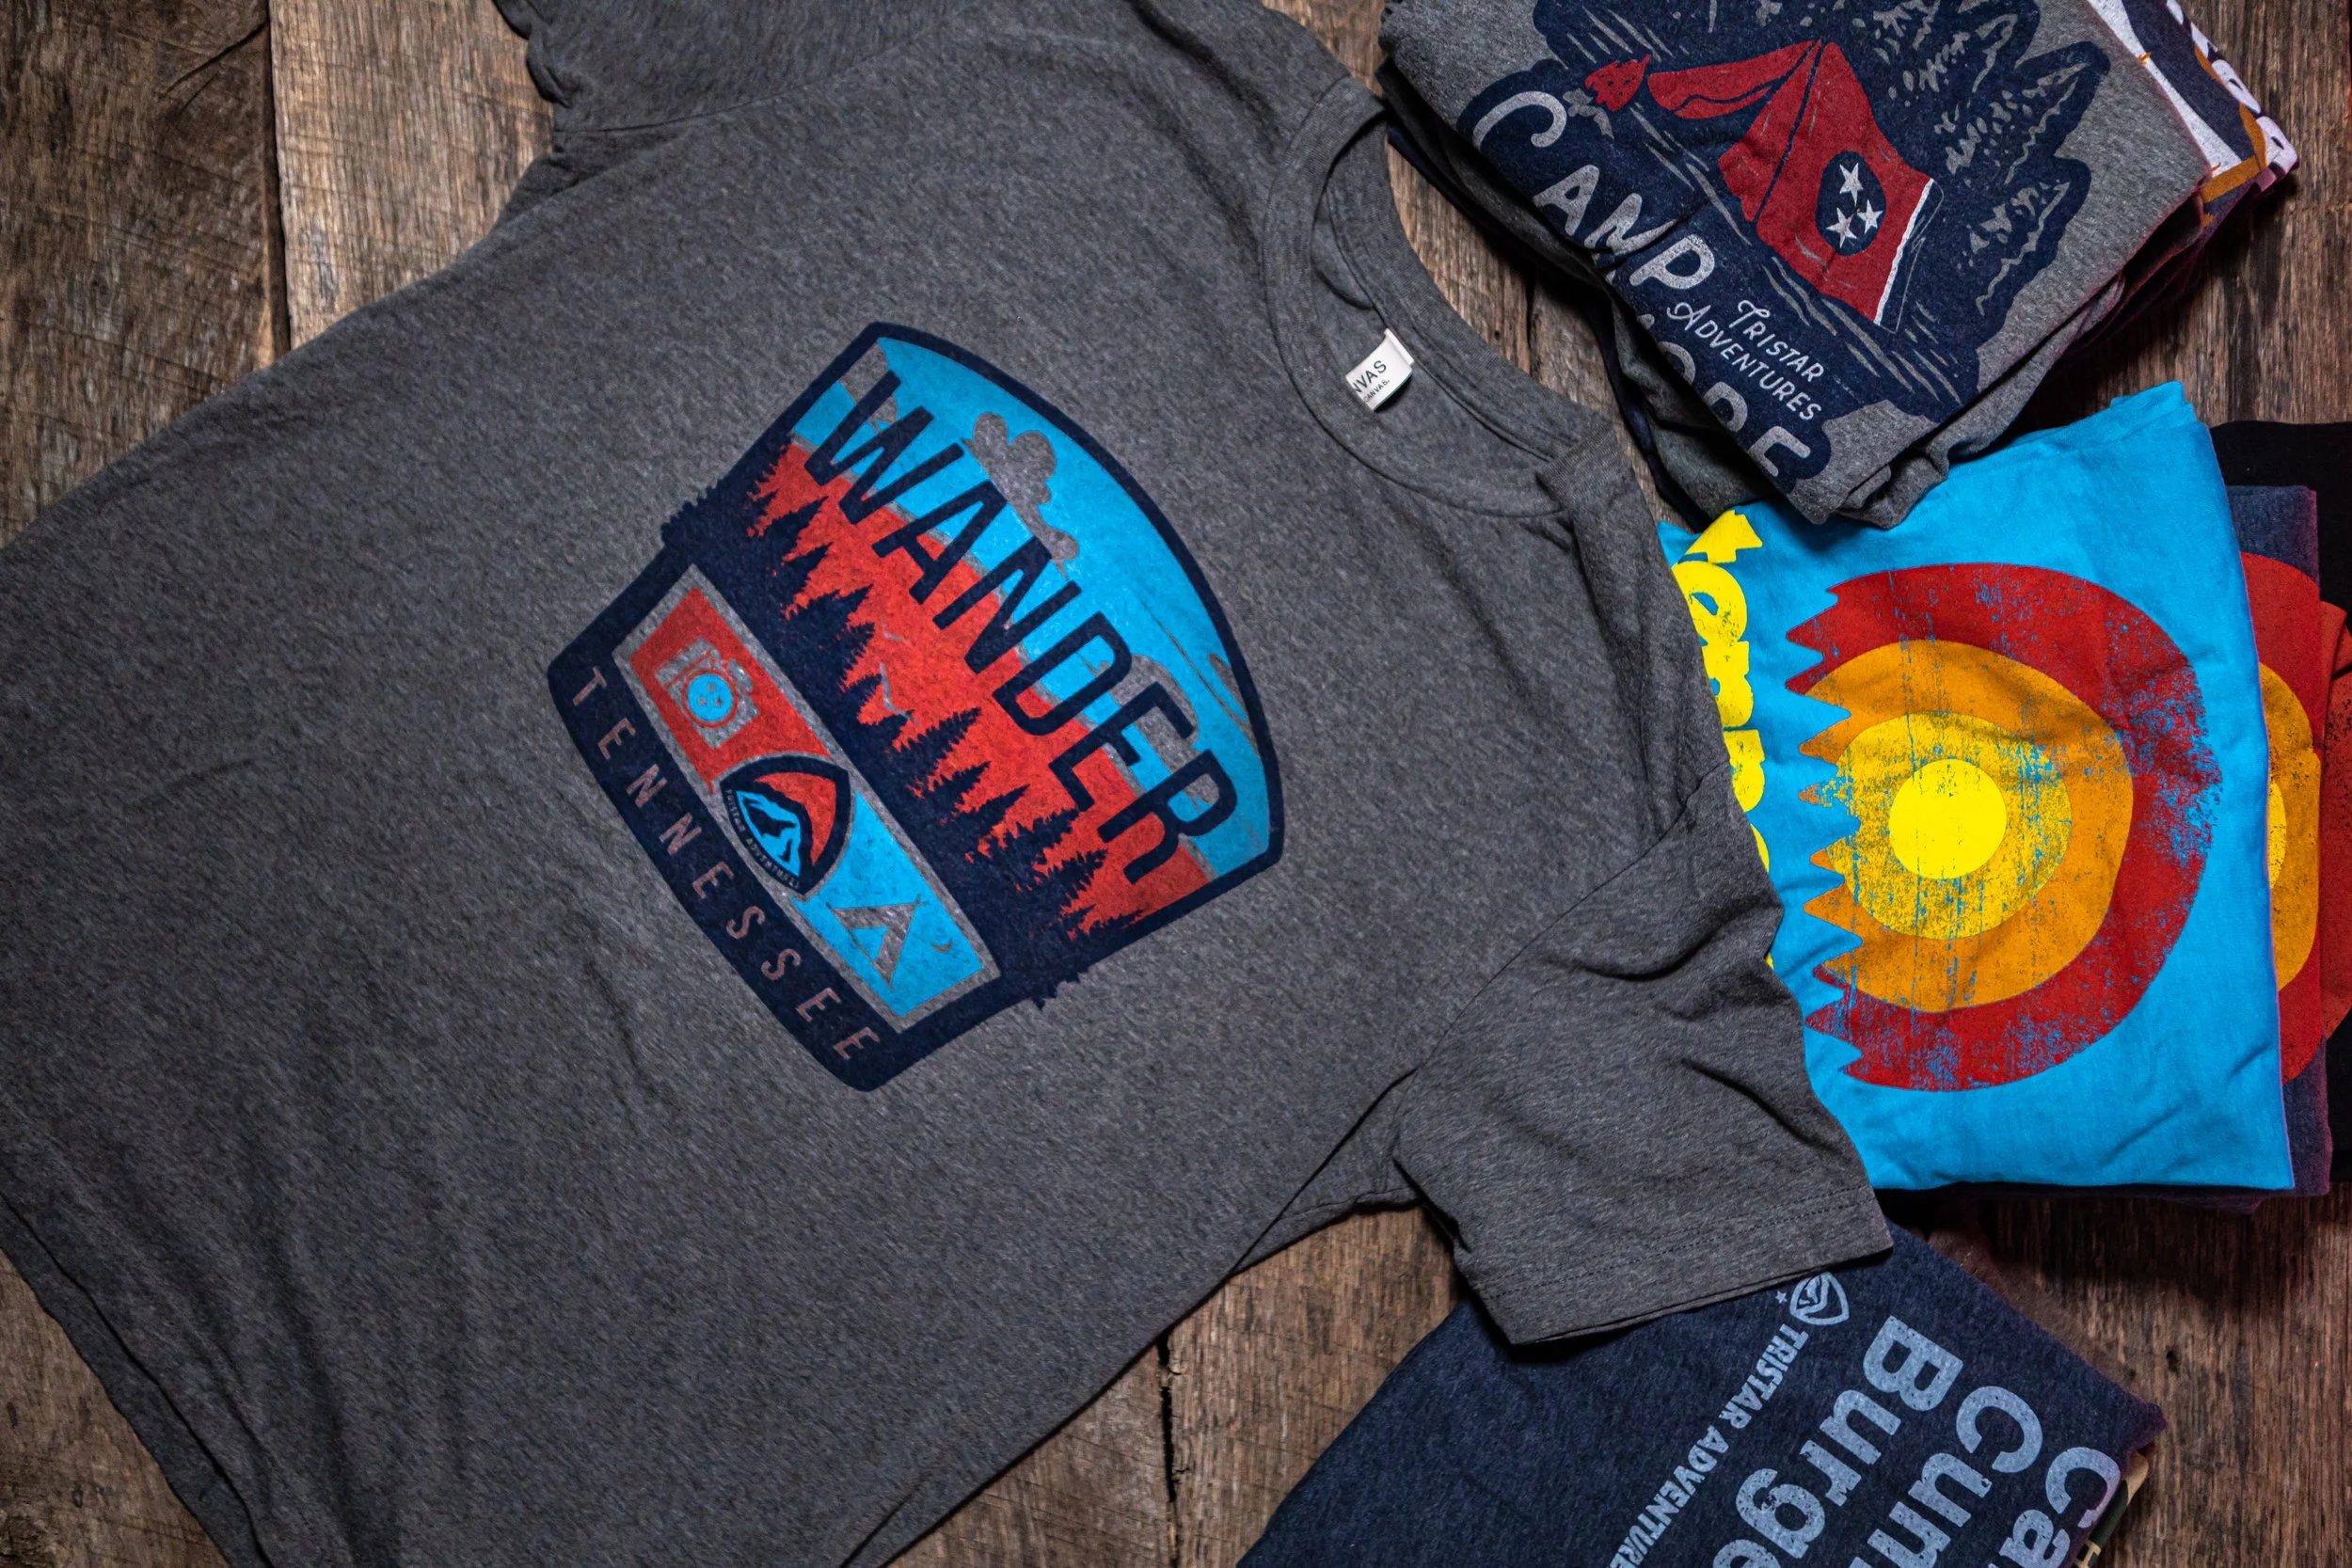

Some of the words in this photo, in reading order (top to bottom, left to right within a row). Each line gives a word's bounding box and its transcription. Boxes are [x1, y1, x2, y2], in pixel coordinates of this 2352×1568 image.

[1472, 90, 1716, 291] CAMP
[1666, 301, 1822, 420] ADVENTURES
[1728, 299, 1825, 383] TRISTAR
[803, 370, 1239, 885] WANDER
[572, 666, 881, 1060] TENNESSEE
[1718, 1323, 1809, 1430] TRISTAR
[1606, 1425, 1729, 1568] ADVENTURE
[1988, 1447, 2122, 1568] Ca
